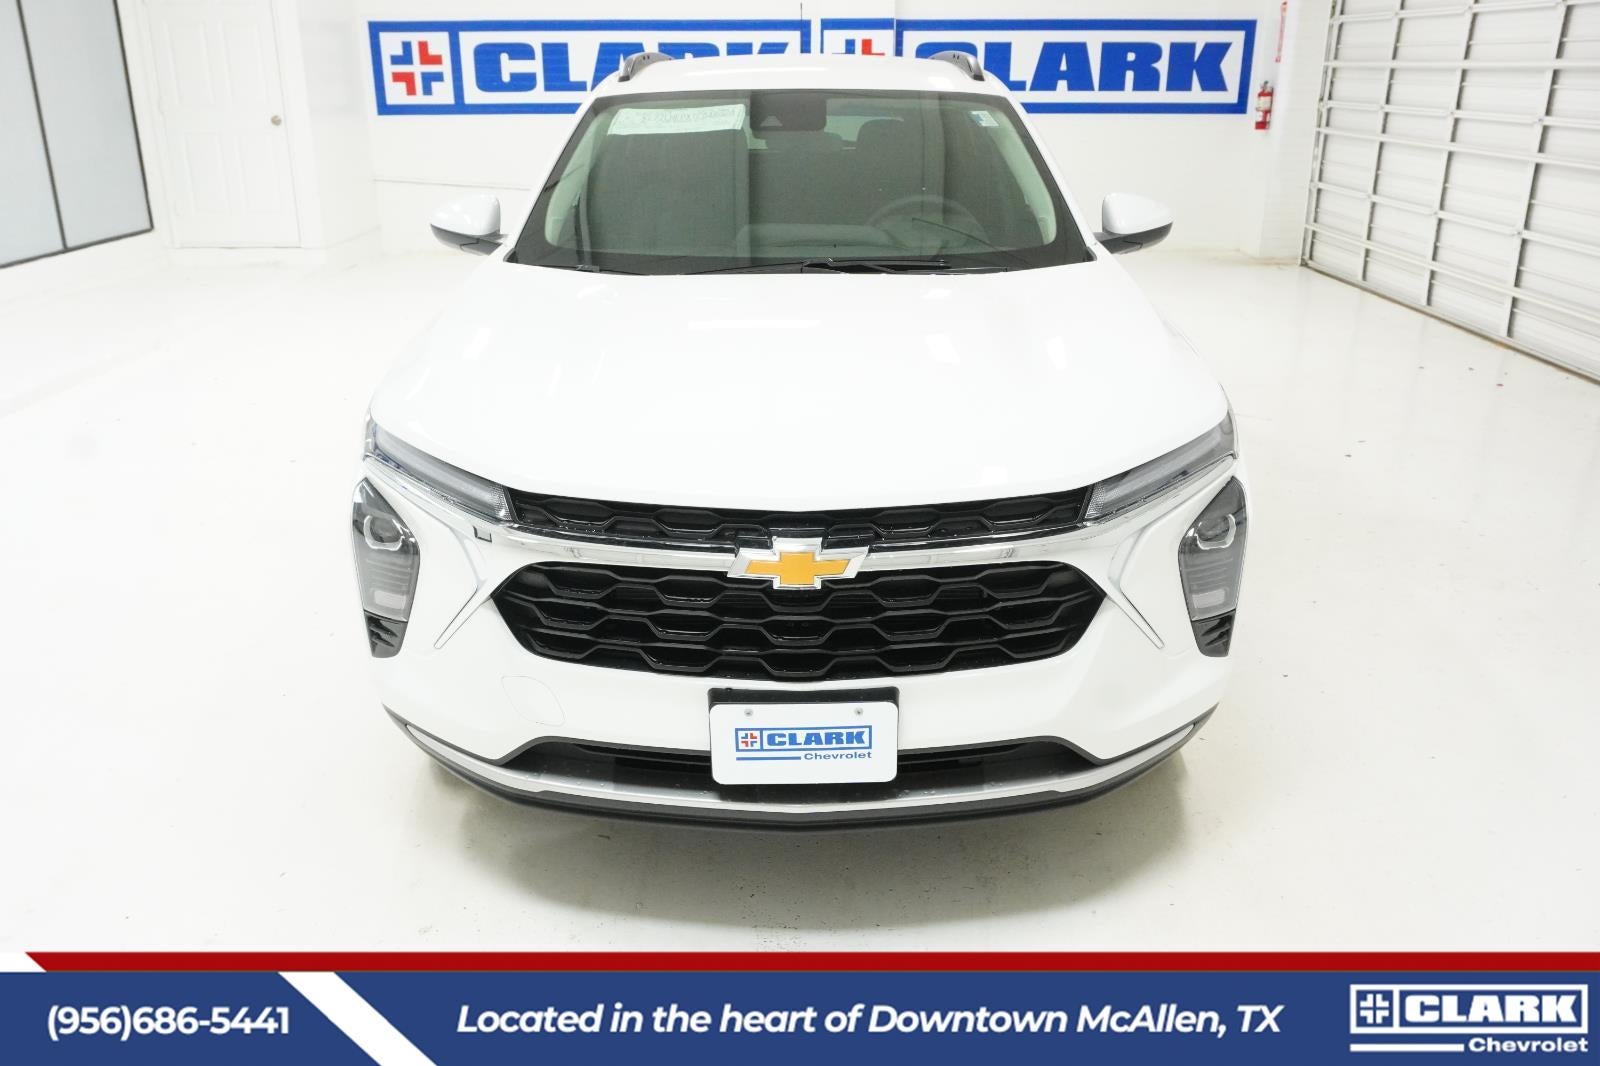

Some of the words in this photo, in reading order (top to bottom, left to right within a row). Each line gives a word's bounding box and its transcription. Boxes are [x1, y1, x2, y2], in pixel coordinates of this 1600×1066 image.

[473, 41, 788, 93] CLA
[915, 40, 1232, 92] LARK
[766, 731, 865, 747] CLARK
[804, 751, 873, 761] Chevrolet
